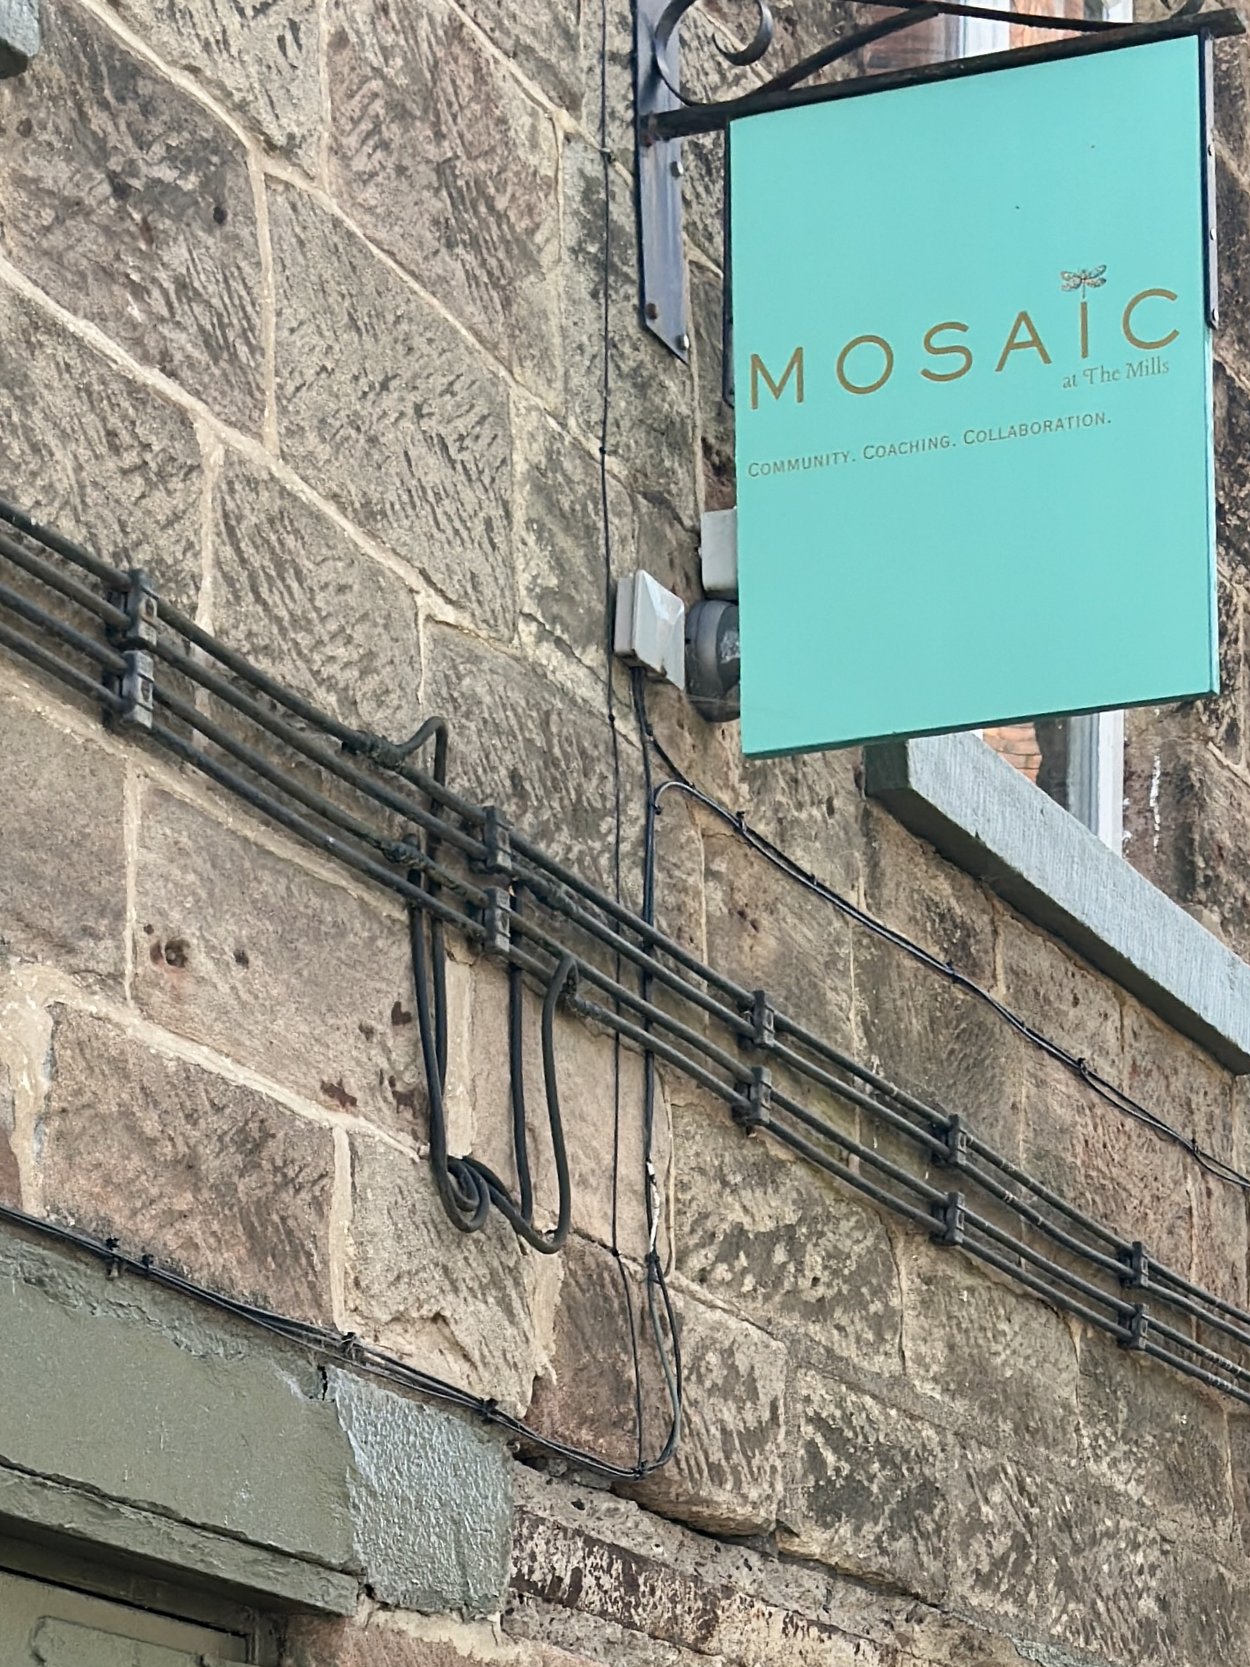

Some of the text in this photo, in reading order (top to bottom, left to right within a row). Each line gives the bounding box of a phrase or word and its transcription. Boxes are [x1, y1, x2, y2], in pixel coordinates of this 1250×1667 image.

[750, 288, 1180, 410] MOSAIC
[1062, 356, 1170, 388] at The Mills
[747, 411, 1112, 479] COMMUNITY. COACHING. COLLABORATION.
